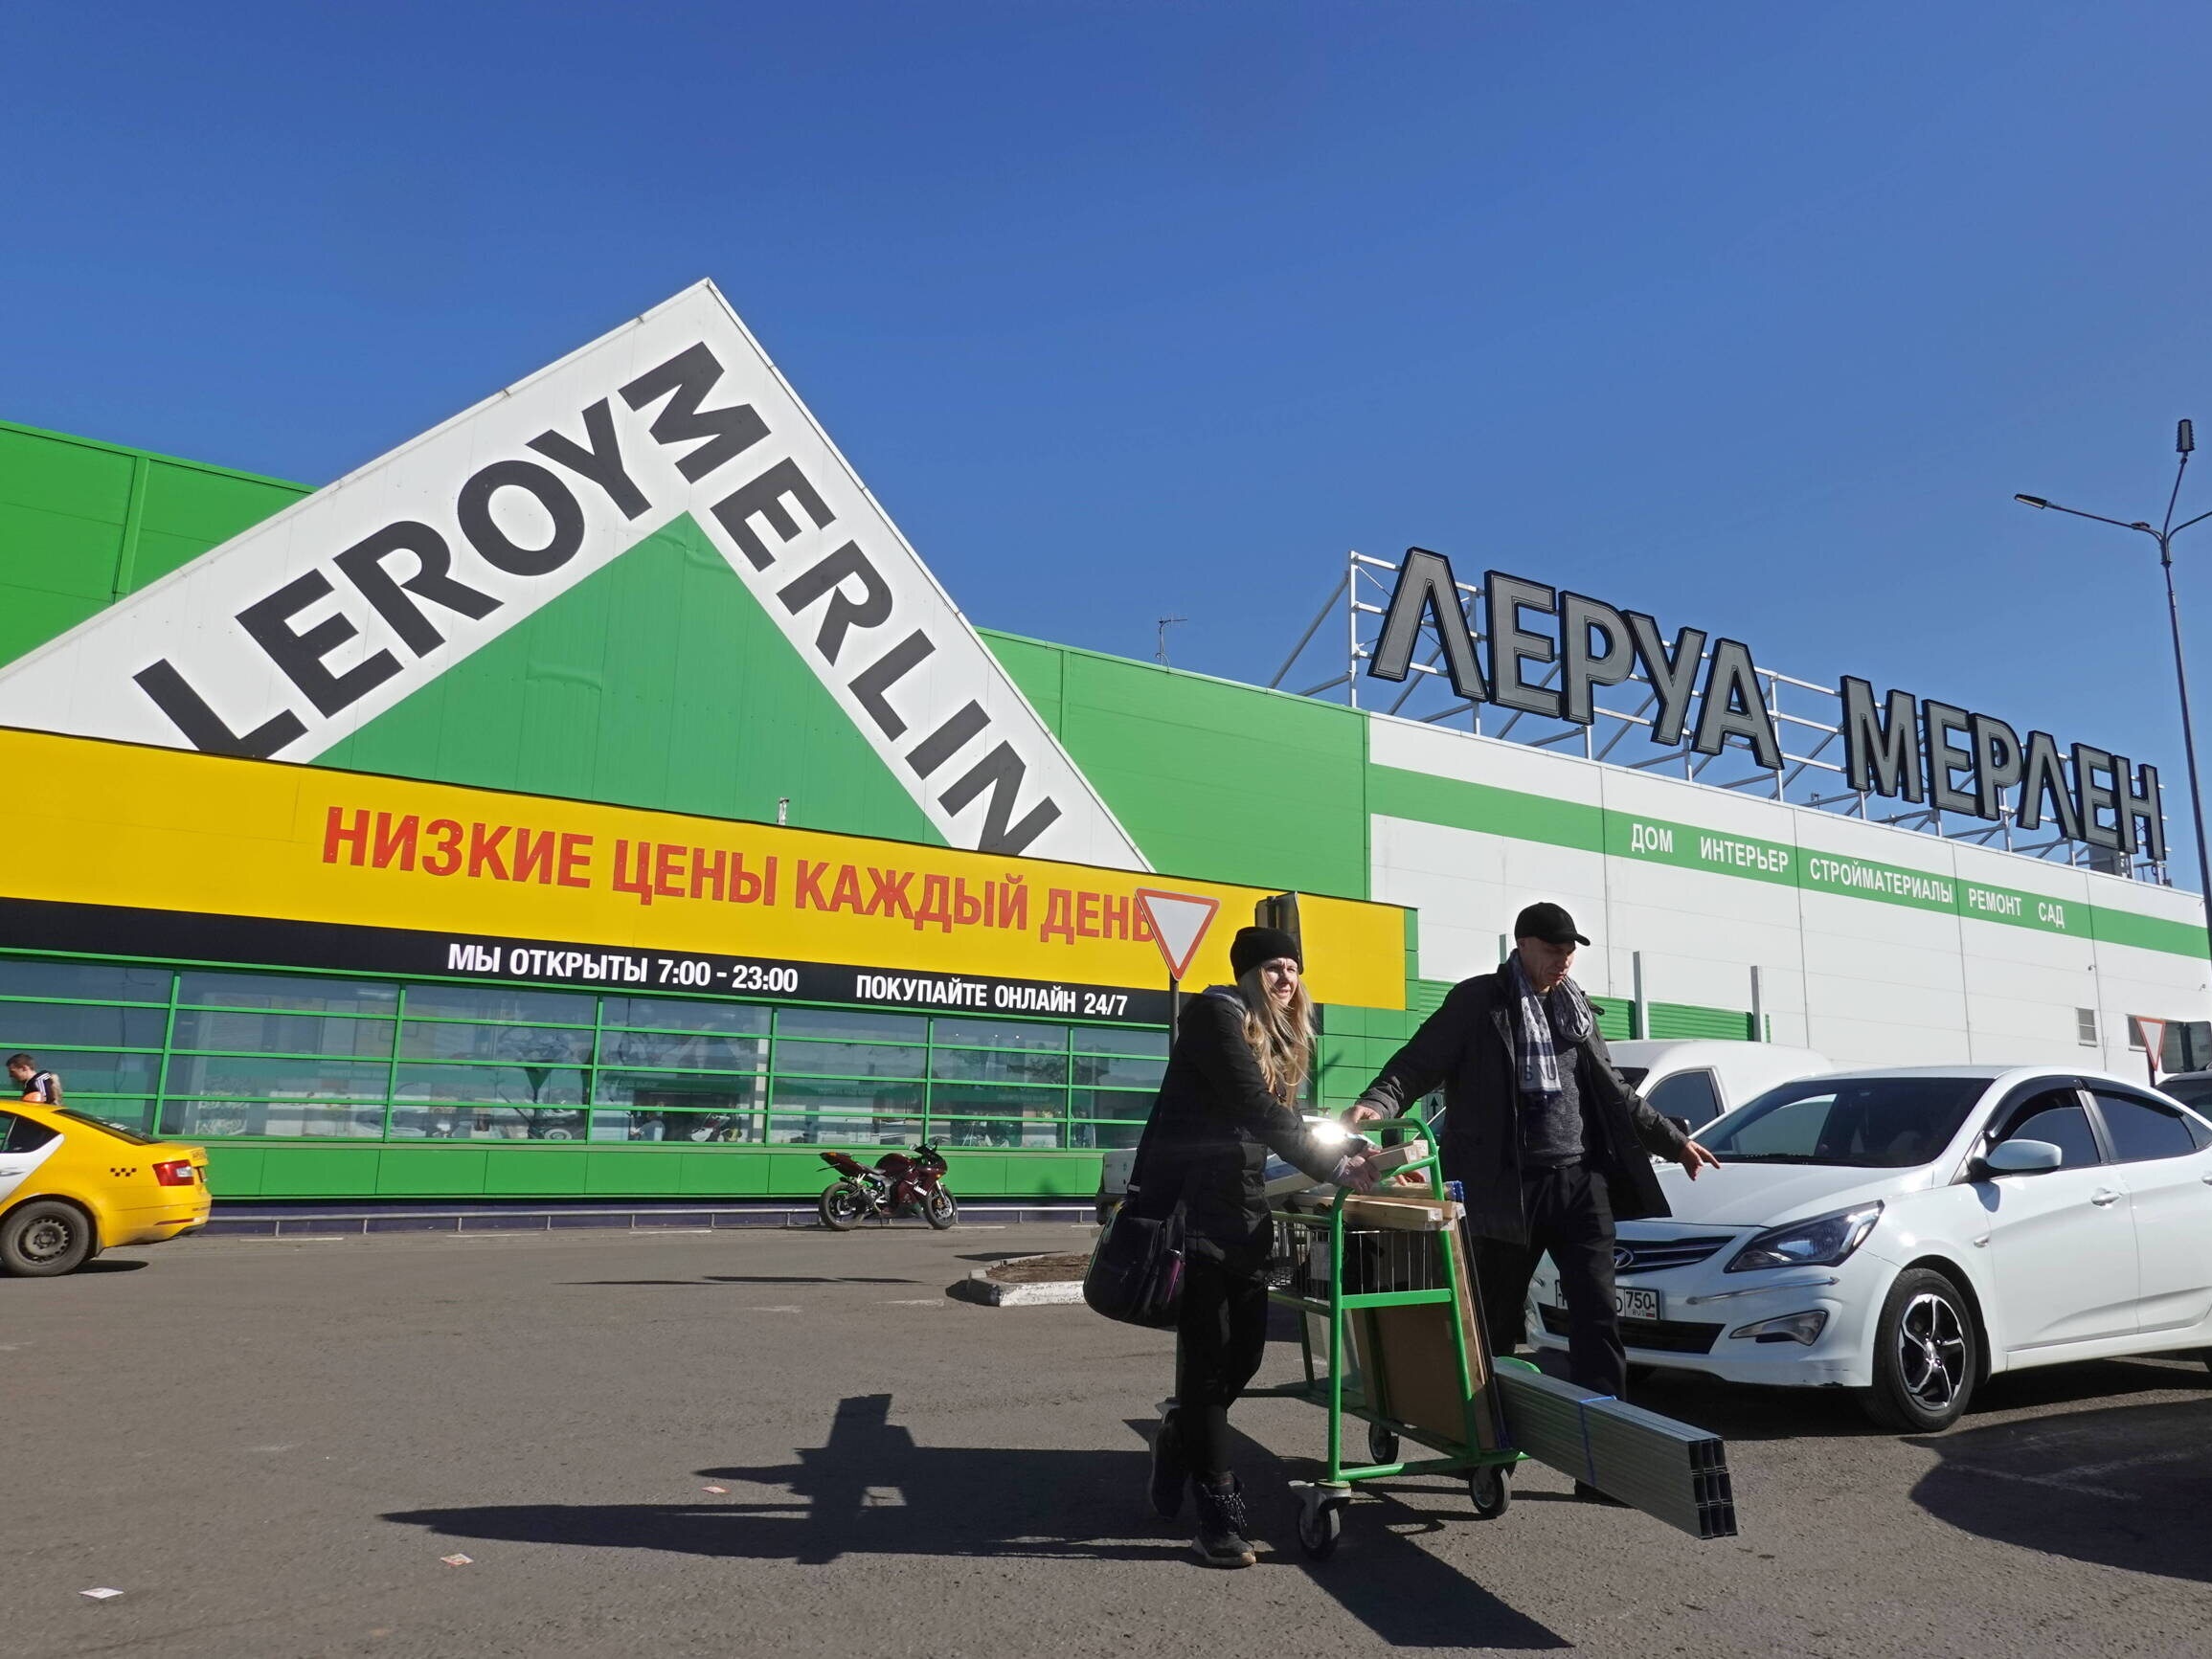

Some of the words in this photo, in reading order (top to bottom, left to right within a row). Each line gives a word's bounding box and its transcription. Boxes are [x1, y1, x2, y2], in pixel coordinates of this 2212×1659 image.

[132, 396, 653, 760] LEROY
[618, 340, 1062, 856] MERLIN
[1367, 546, 1785, 770] ЛЕРУА
[1840, 675, 2165, 861] МЕРЛЕН
[323, 806, 594, 888] НИЗКИЕ
[613, 840, 778, 906] ЦЕНЫ
[795, 859, 1027, 933] КАЖДЫЙ
[1631, 823, 1674, 854] ДОМ
[1700, 836, 1789, 873] ИНТЕРЬЕР
[1809, 858, 1953, 905] СТРОЙМАТЕРИАЛЫ
[1968, 887, 2022, 917] РЕМОНТ
[2038, 902, 2065, 929] САД
[448, 943, 500, 973] МЫ
[509, 948, 647, 983] ОТКРЫТЫ
[658, 958, 711, 986] 7:00
[732, 964, 799, 993] 23:00
[856, 975, 987, 1007] ПОКУПАЙТЕ
[994, 985, 1076, 1014] ОНЛАЙН
[1084, 993, 1128, 1017] 24/7
[1626, 1290, 1652, 1311] 750
